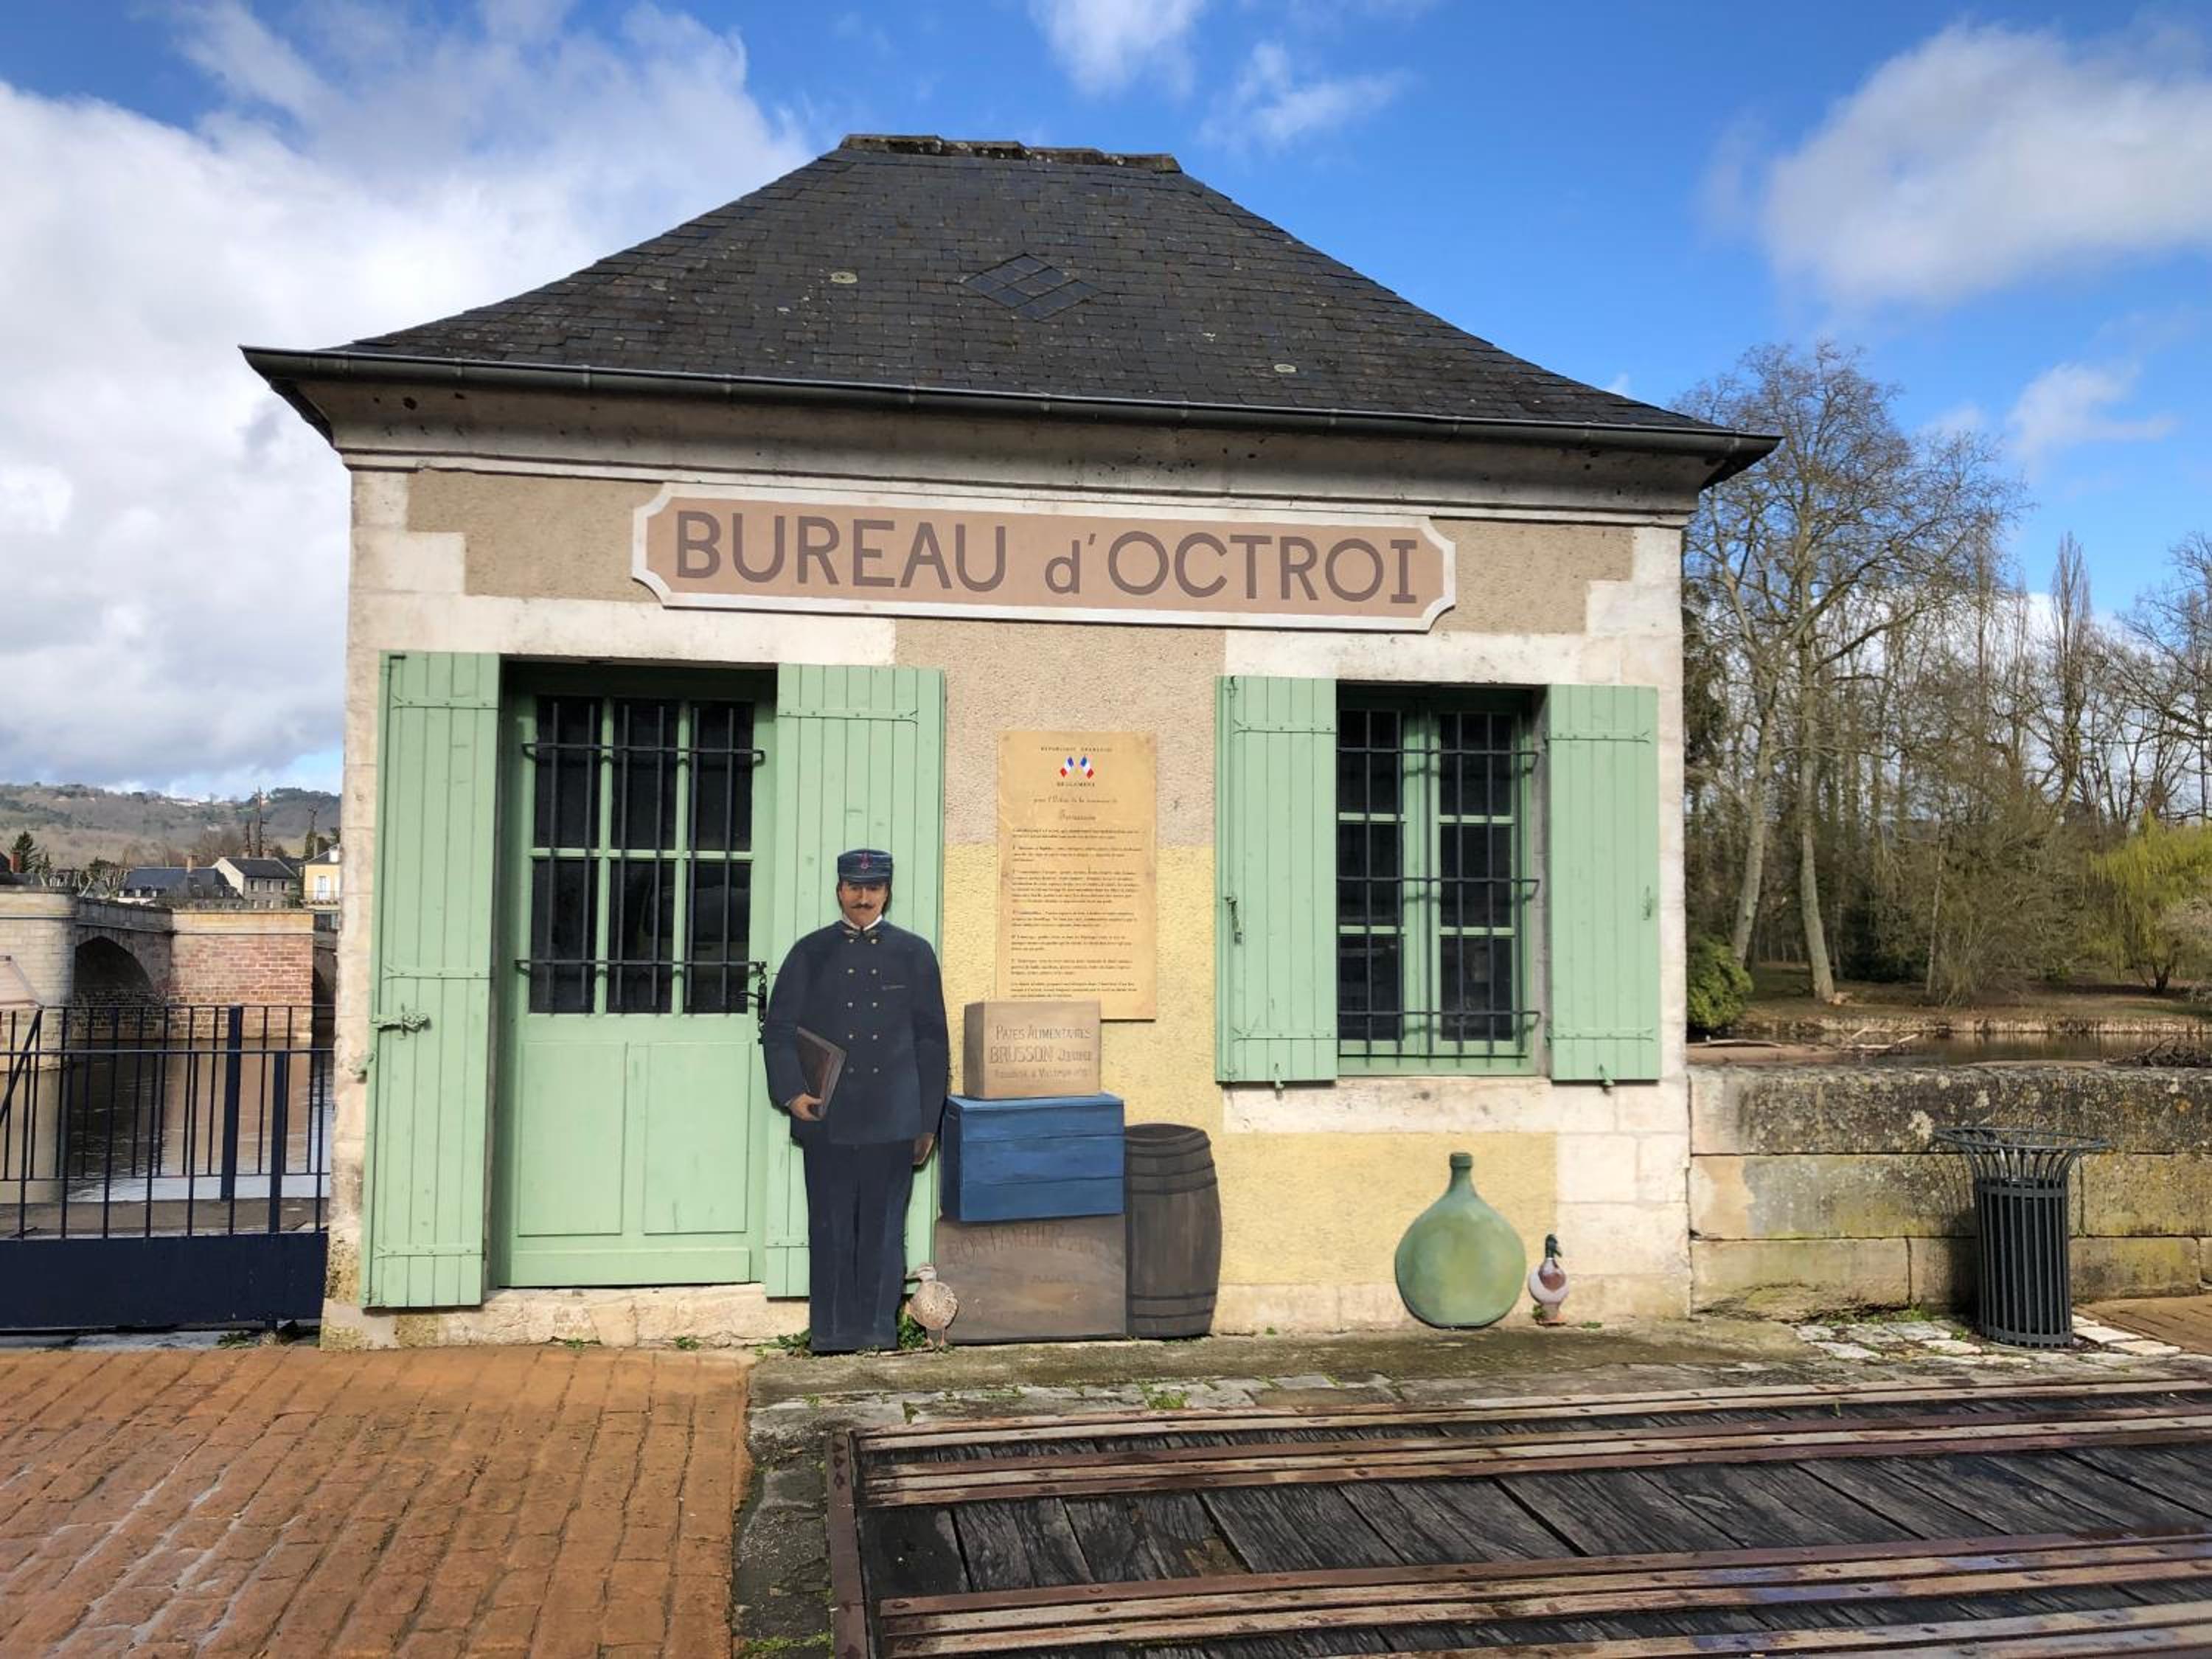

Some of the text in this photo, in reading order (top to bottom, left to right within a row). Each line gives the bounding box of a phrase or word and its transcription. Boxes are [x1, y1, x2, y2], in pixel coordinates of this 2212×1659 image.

[676, 510, 1417, 604] BUREAU d'OCTROI
[990, 1045, 1052, 1063] BRUSSON
